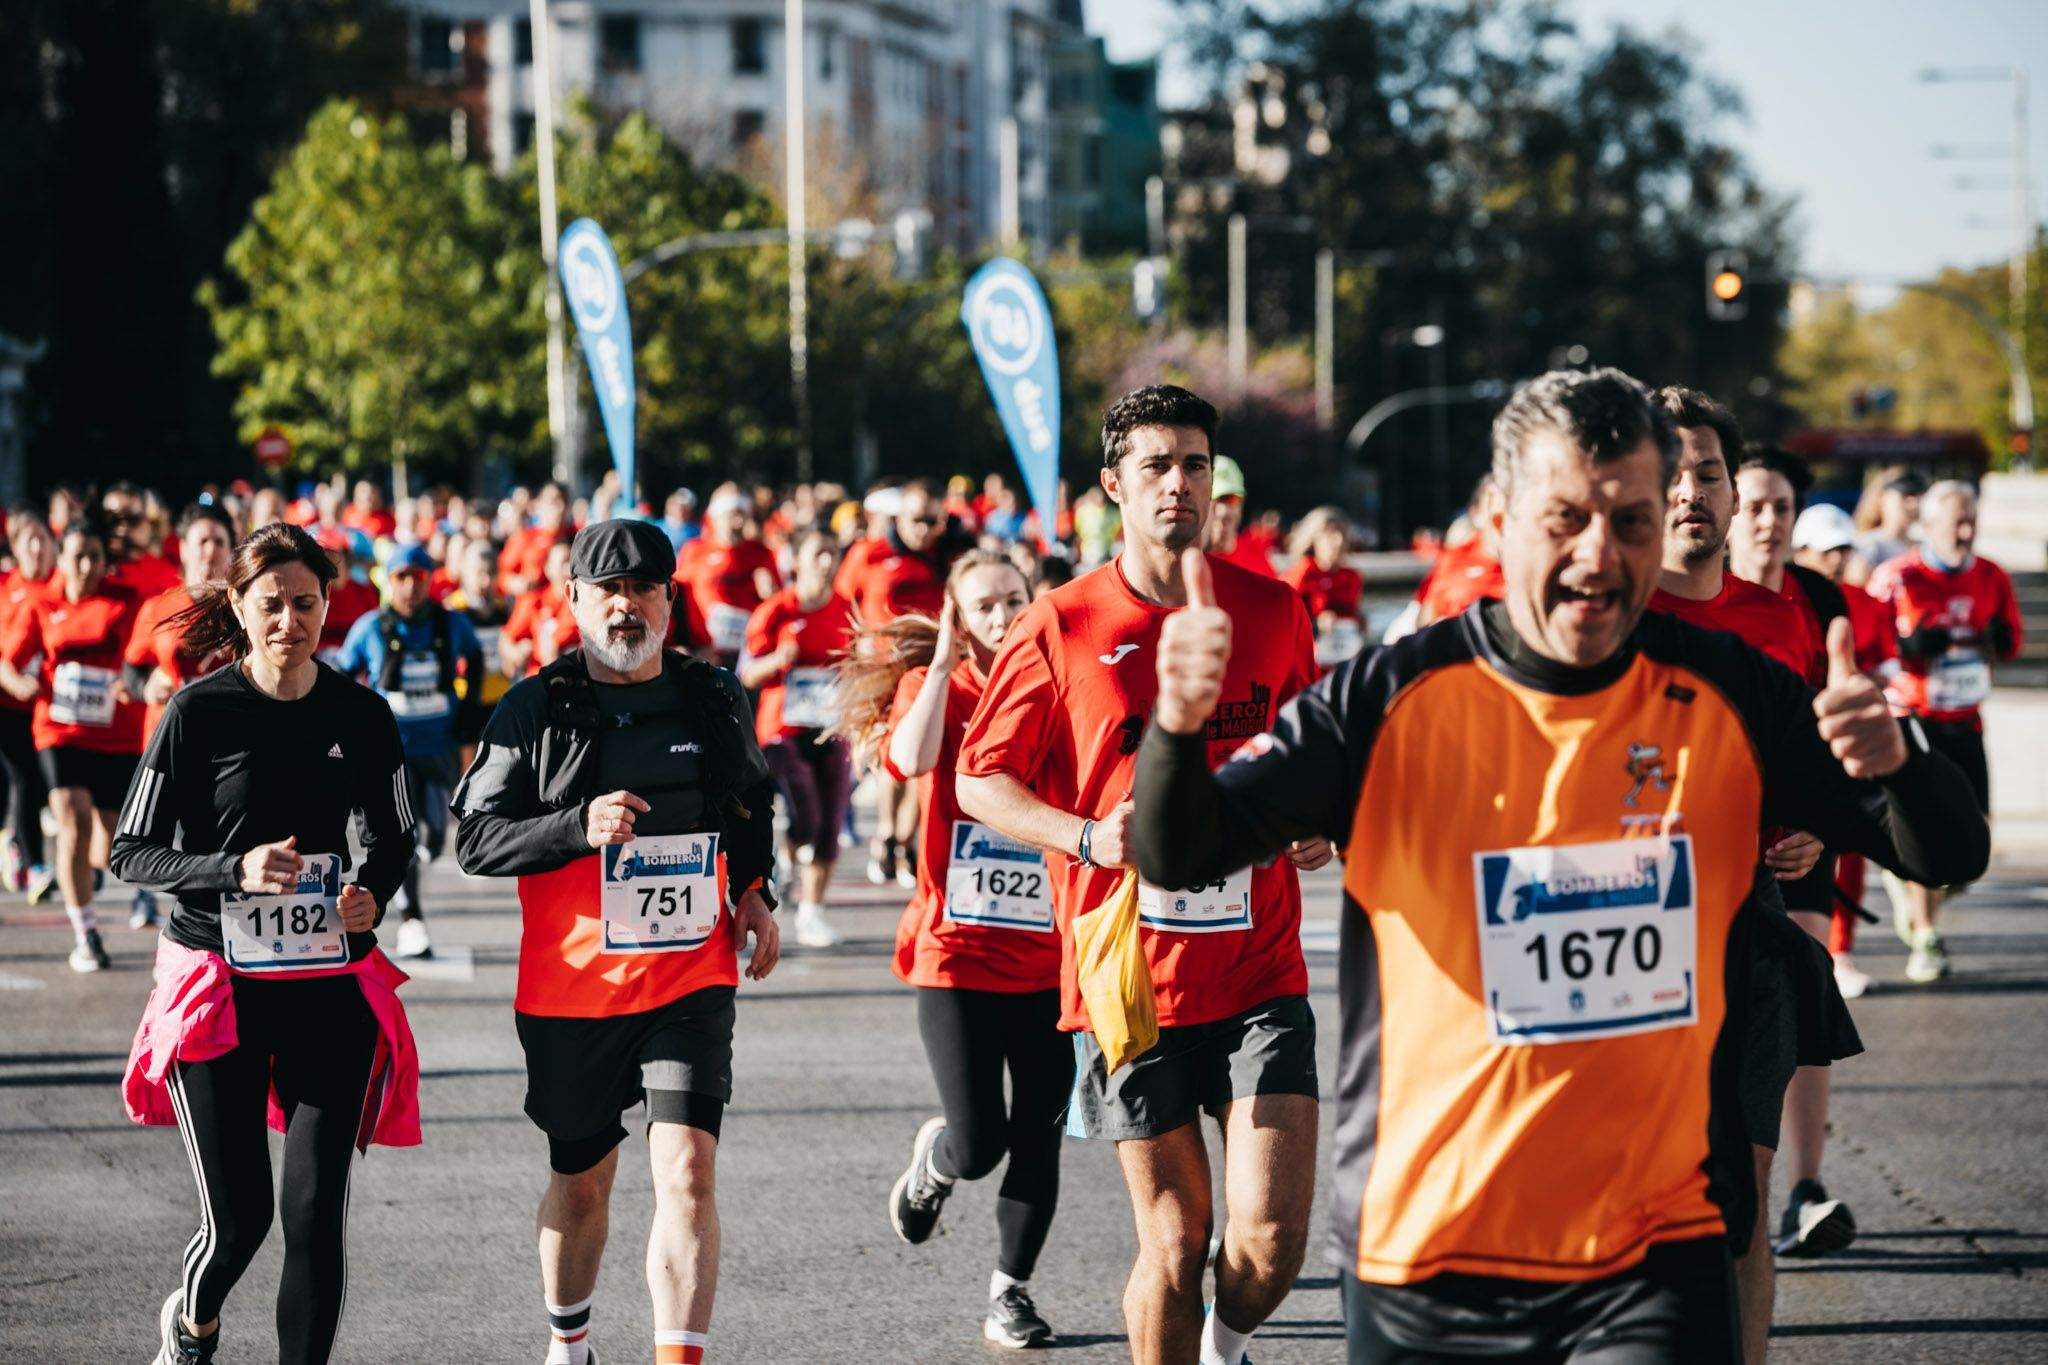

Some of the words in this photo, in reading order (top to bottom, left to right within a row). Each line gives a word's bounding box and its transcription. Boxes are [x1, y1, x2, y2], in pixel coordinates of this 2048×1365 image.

[643, 853, 702, 866] BOMBEROS
[295, 873, 320, 884] EROS
[972, 868, 1041, 899] 1622
[637, 885, 692, 917] 751
[247, 903, 328, 937] 1182
[1525, 924, 1662, 983] 1670
